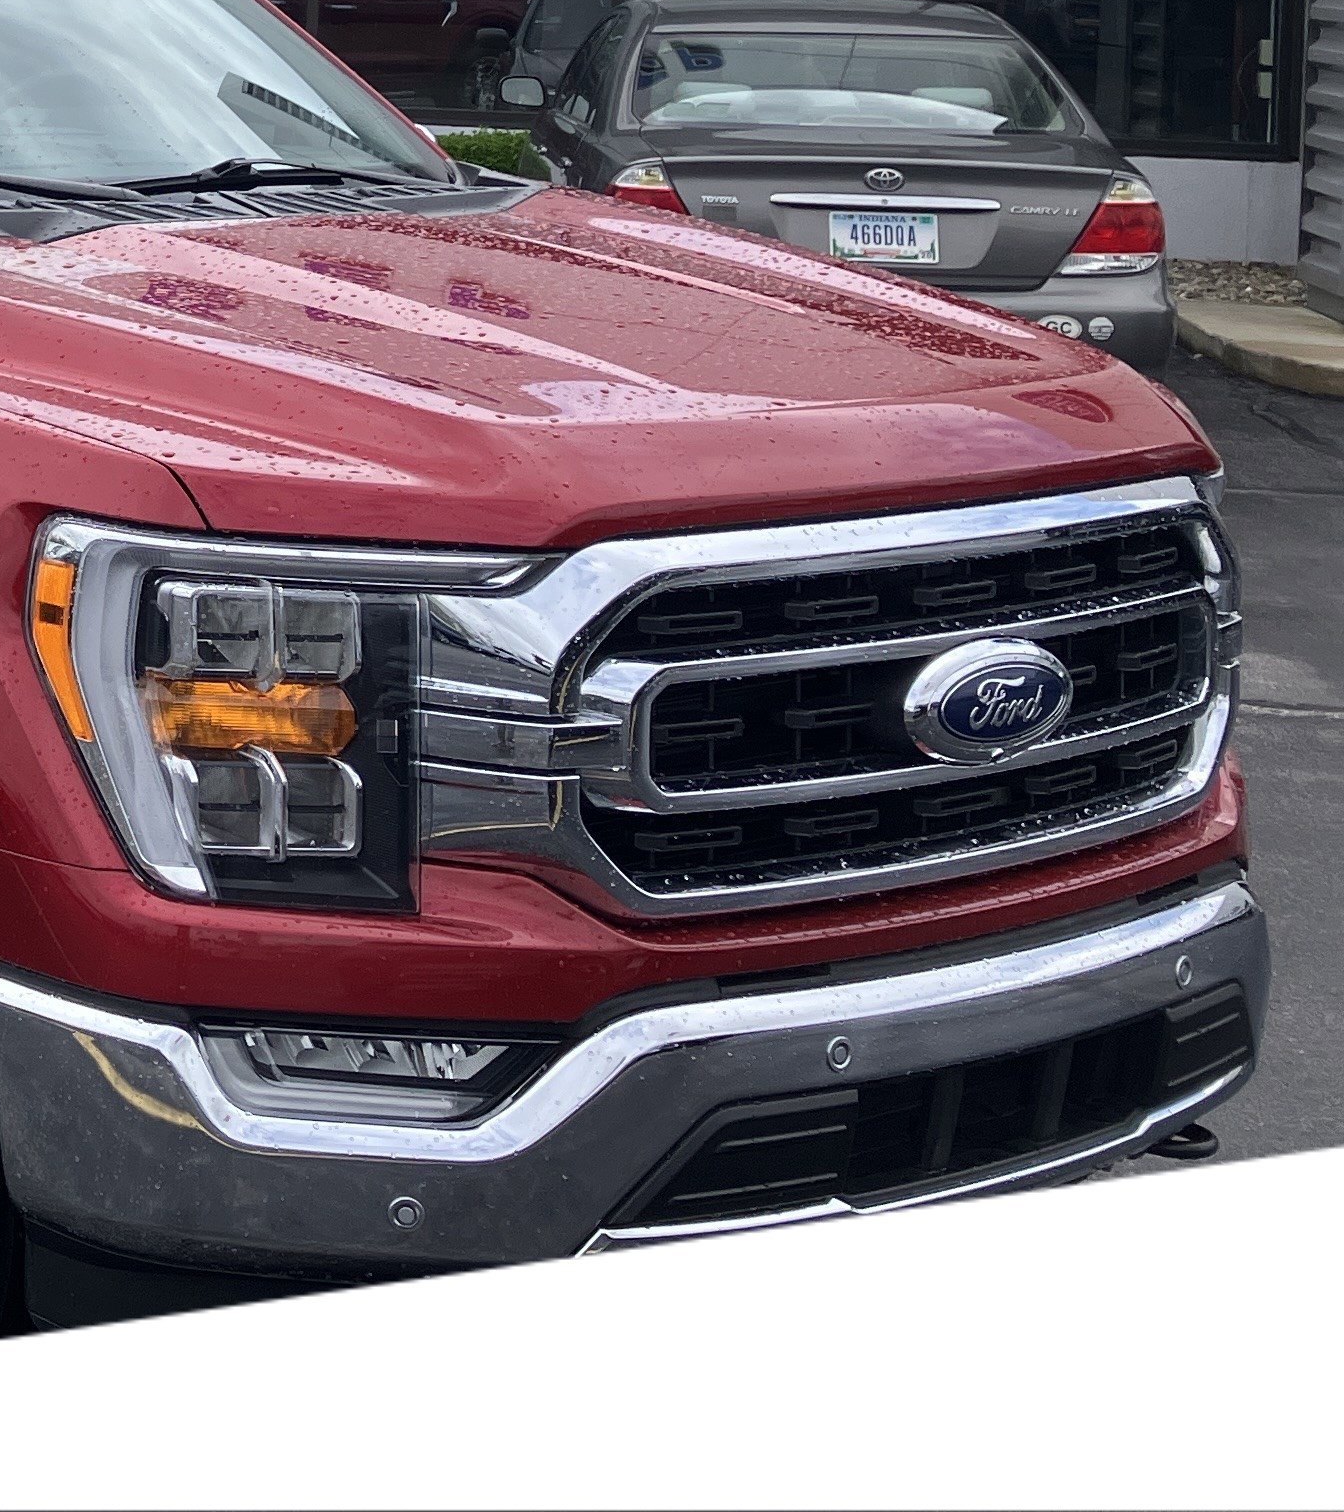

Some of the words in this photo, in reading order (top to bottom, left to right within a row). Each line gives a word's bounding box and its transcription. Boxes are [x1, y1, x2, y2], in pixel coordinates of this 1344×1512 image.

[701, 195, 740, 204] TOYOTA
[1010, 205, 1062, 215] CAMRY
[858, 214, 907, 223] INDIANA
[969, 675, 1044, 731] Ford
